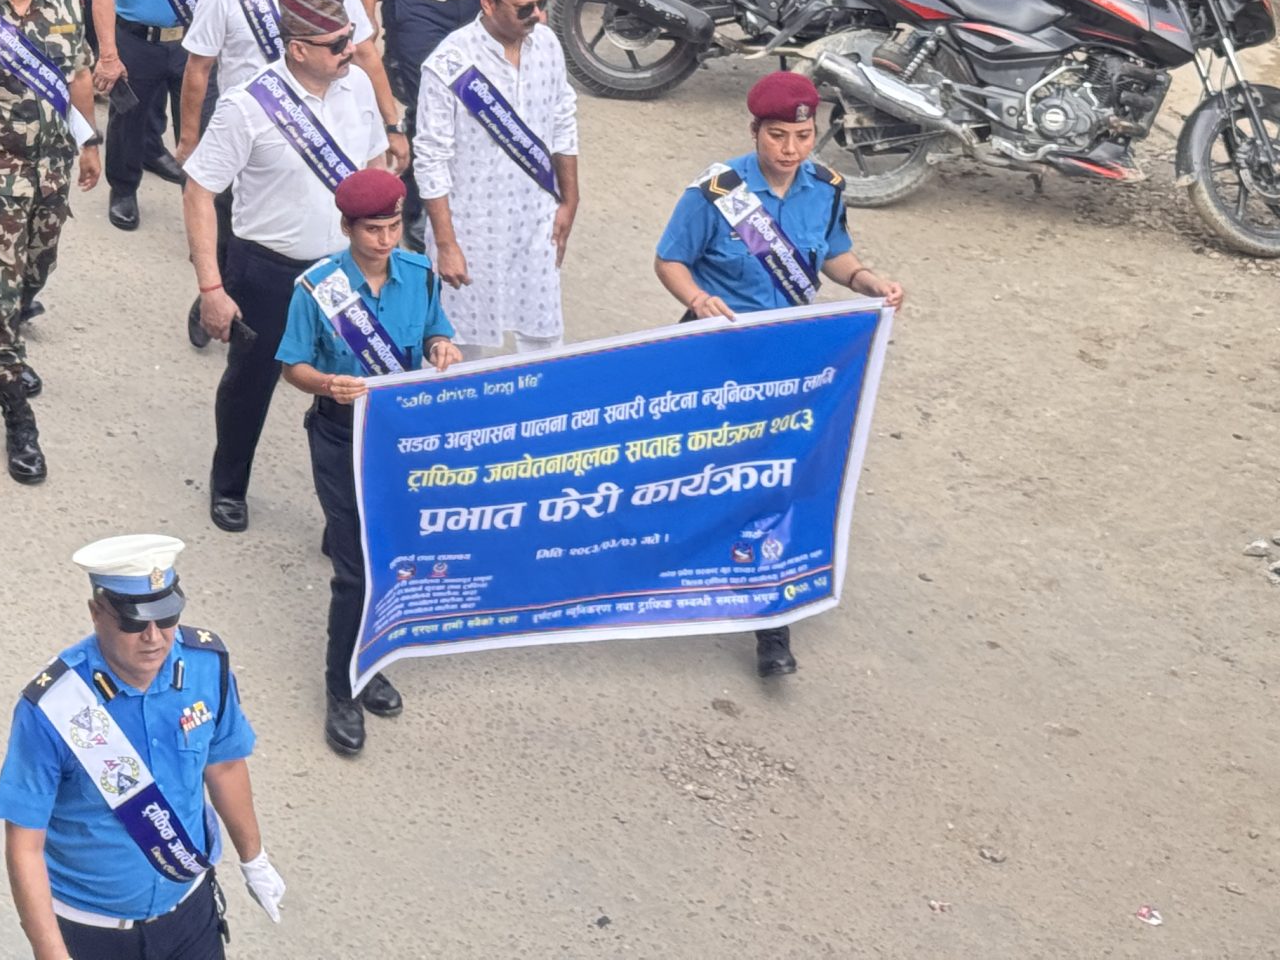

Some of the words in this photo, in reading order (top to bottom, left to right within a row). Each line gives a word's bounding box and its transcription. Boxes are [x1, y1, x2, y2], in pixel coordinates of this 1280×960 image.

[397, 433, 442, 454] सडक
[443, 422, 518, 452] अनुशासन
[520, 413, 568, 440] पालना
[571, 407, 600, 429] तथा
[603, 394, 646, 425] सवारी
[648, 389, 699, 421] दुर्घटना
[701, 377, 800, 411] न्यूनिकरणका
[483, 380, 515, 397] long
[406, 463, 480, 492] ट्राफिक
[483, 444, 621, 484] जनचेतनामूलक
[624, 433, 684, 464] सप्ताह
[687, 420, 769, 451] कार्यक्रम
[769, 408, 815, 434] २०८३
[419, 501, 528, 536] प्रभात
[538, 481, 625, 524] फेरी
[630, 458, 797, 507] कार्यक्रम
[141, 801, 178, 840] ट्राफिक
